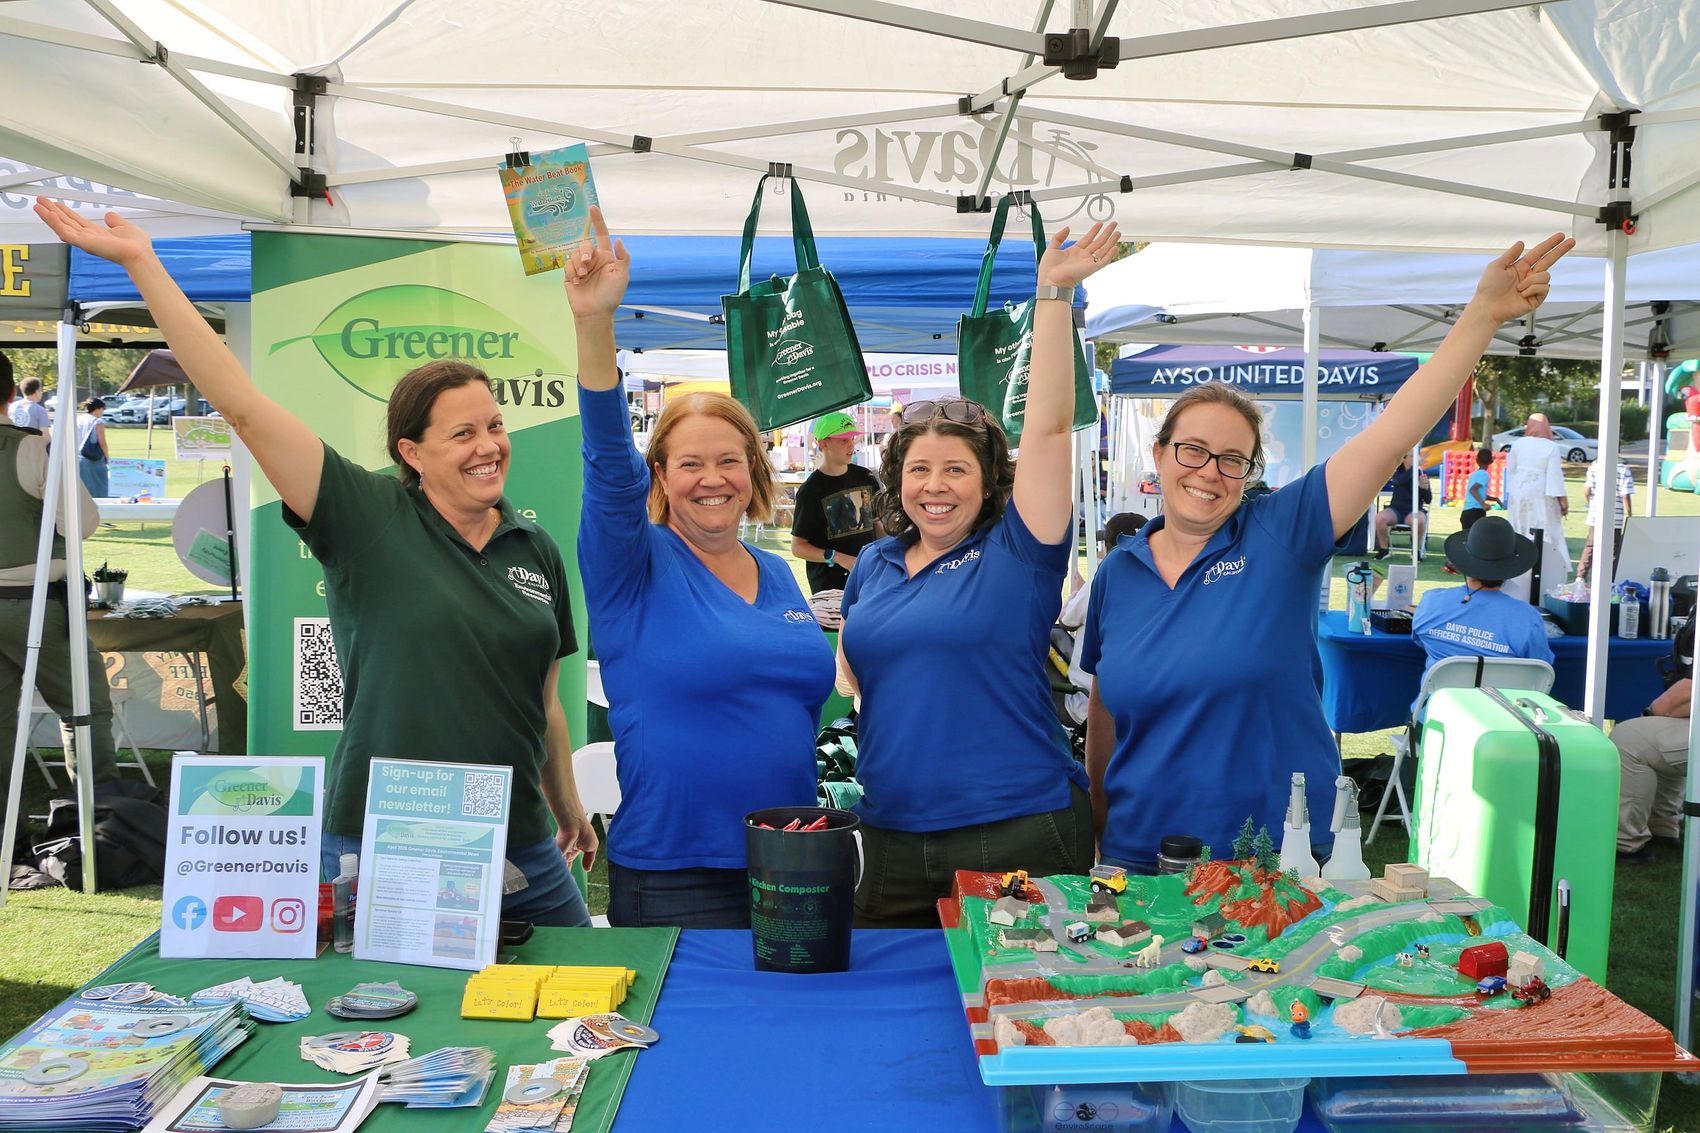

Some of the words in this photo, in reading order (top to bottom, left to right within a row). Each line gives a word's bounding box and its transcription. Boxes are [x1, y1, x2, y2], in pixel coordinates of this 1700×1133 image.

[510, 178, 524, 188] The
[524, 173, 546, 185] Water
[546, 169, 564, 179] Beat
[564, 163, 582, 175] Book
[341, 318, 519, 359] Greener
[895, 363, 942, 377] CRISIS
[1150, 366, 1213, 385] AYSO
[1219, 364, 1304, 385] UNITED
[492, 368, 565, 408] avis
[777, 380, 822, 400] GreenerDavis.org
[517, 567, 550, 590] Davis
[1446, 622, 1468, 634] DAVIS
[1468, 627, 1494, 641] POLICE
[1461, 635, 1510, 654] ASSOCIATION
[382, 766, 434, 783] Sign-up
[435, 769, 455, 781] for
[214, 779, 268, 793] Greener
[386, 785, 408, 794] our
[410, 785, 447, 797] email
[246, 794, 282, 806] Davis
[378, 799, 451, 814] newsletter!
[181, 826, 262, 845] Follow
[268, 826, 307, 845] us!
[177, 859, 309, 876] @GreenerDavis
[752, 877, 776, 891] Kitchen
[778, 884, 830, 895] Composter
[99, 1003, 140, 1011] Recycling
[473, 997, 492, 1008] Let's
[497, 999, 523, 1009] Color!
[549, 997, 569, 1008] Let's
[572, 999, 599, 1009] Color!
